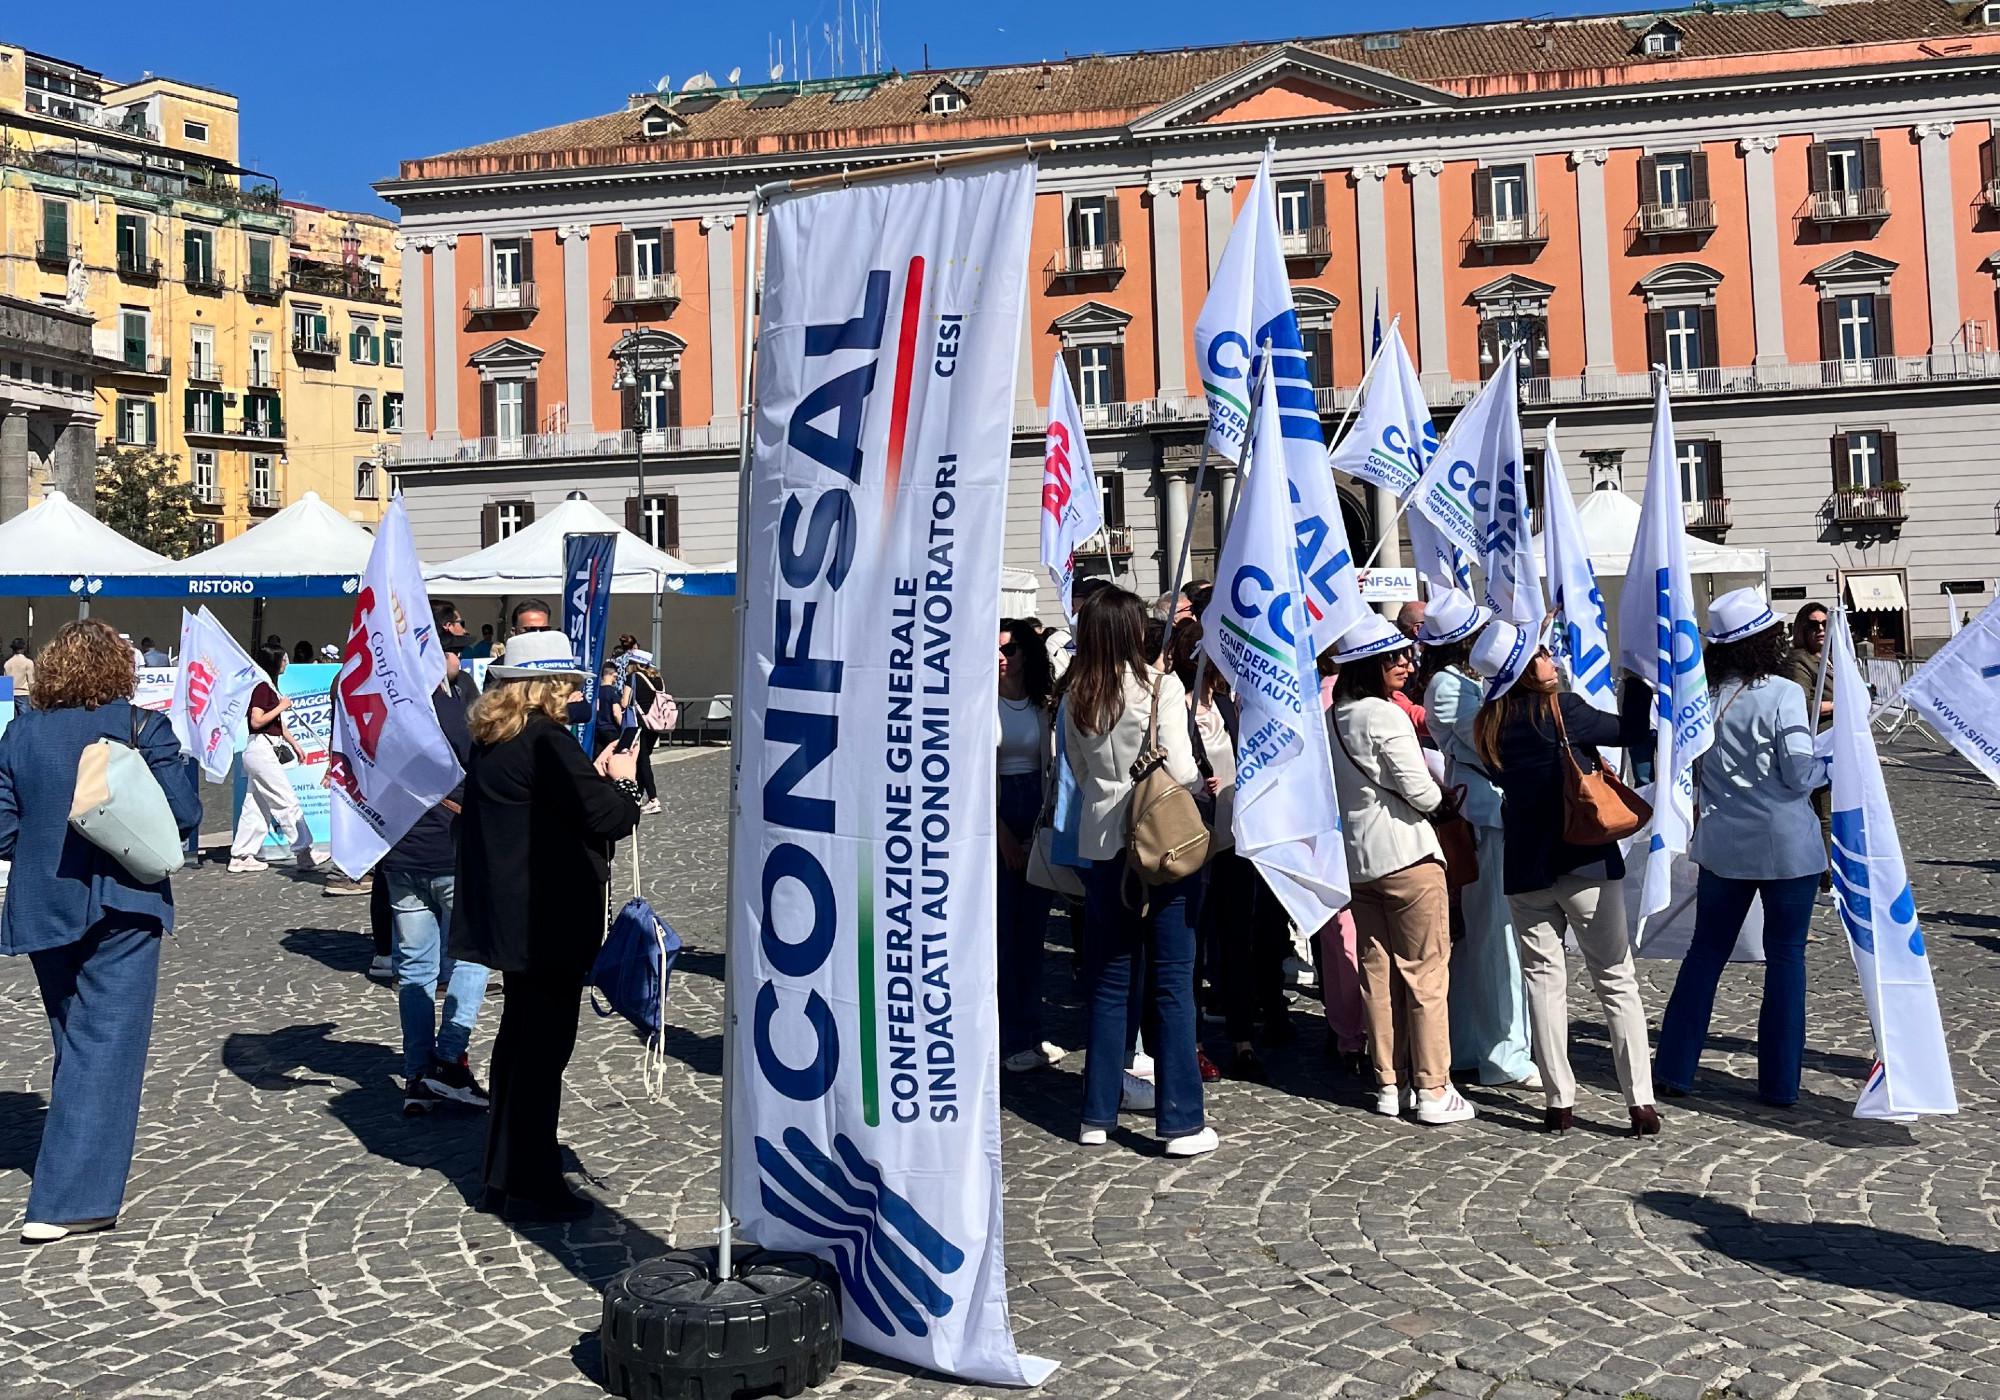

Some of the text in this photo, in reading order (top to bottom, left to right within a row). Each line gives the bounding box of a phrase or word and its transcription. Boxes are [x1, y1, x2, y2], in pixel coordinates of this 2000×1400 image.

[934, 313, 963, 378] CESI
[188, 580, 254, 593] RISTORO
[371, 631, 414, 708] Confsal
[753, 269, 892, 1101] CONFSAL
[886, 576, 921, 1124] CONFEDERAZIONE GENERALE
[921, 453, 959, 1123] SINDACATI AUTONOMI LAVORATORI
